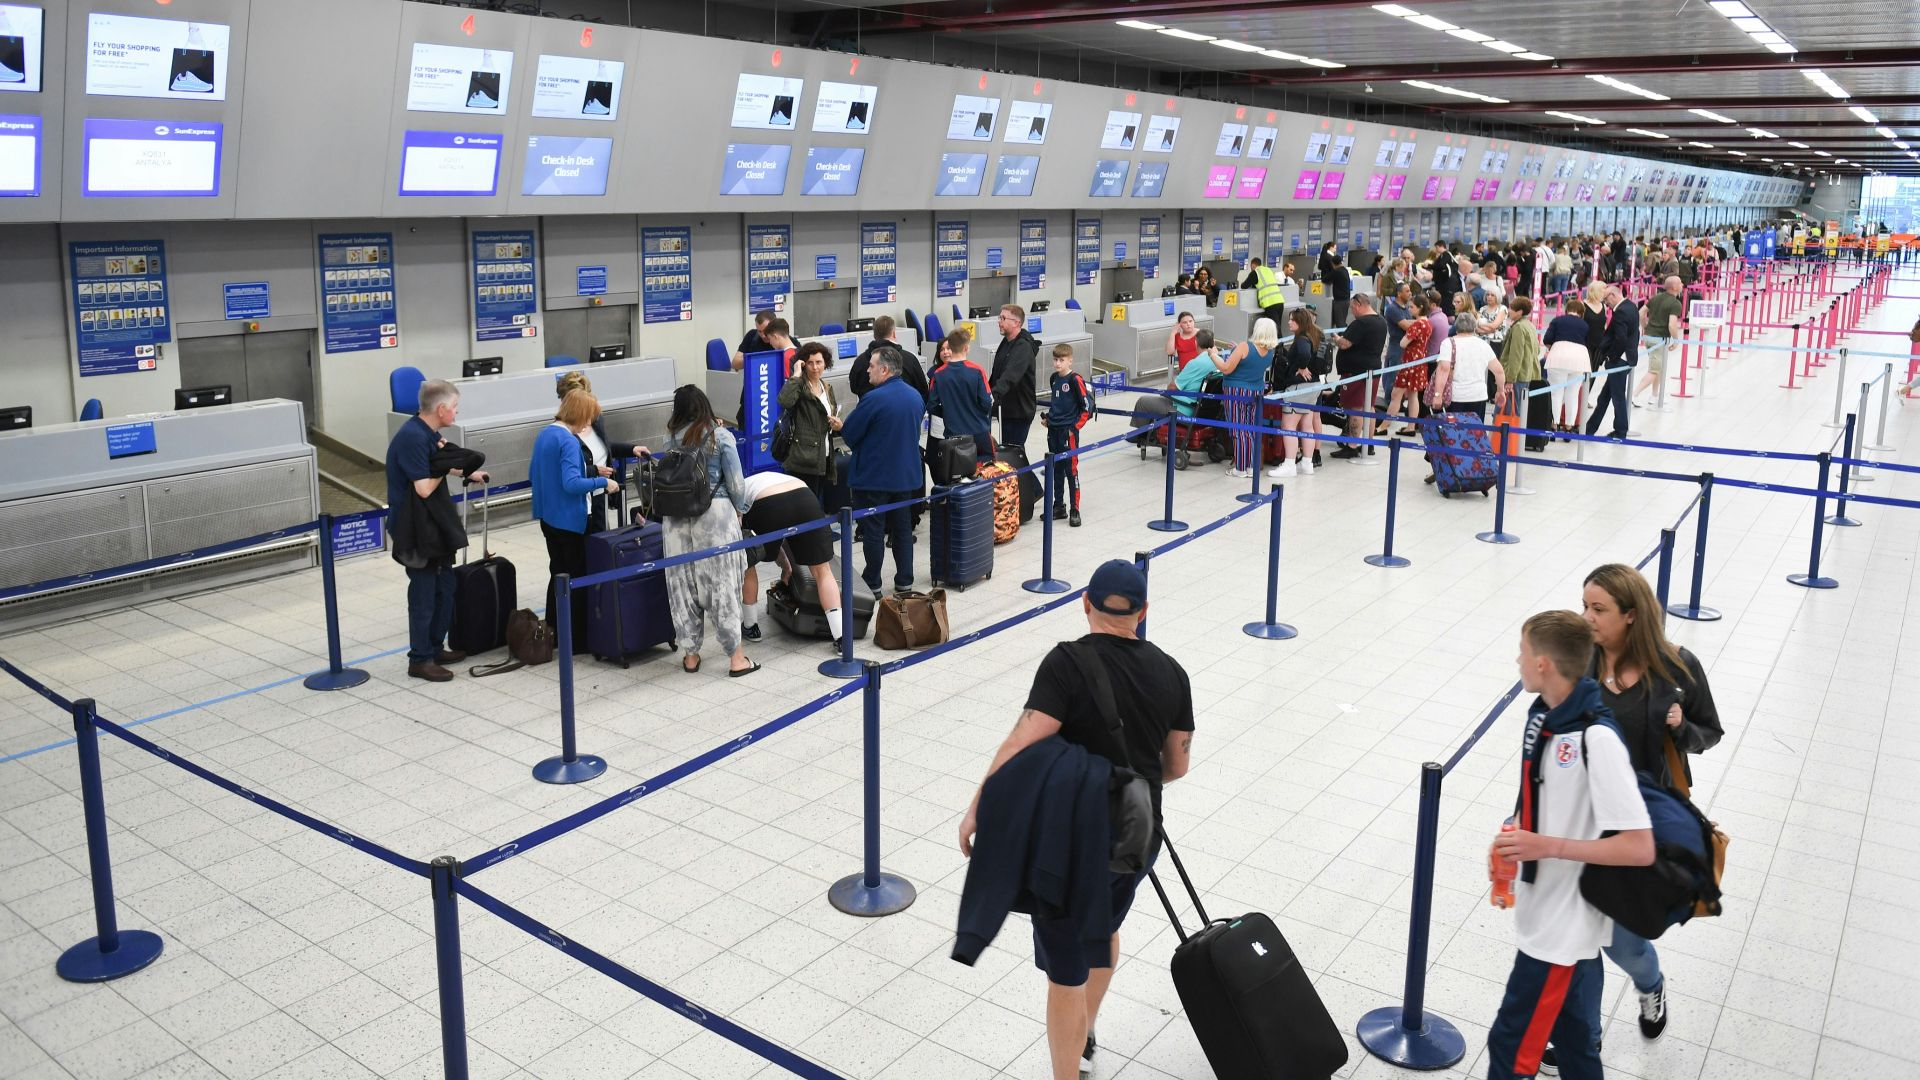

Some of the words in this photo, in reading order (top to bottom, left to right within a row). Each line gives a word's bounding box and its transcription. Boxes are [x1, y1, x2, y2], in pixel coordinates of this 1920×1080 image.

[460, 14, 476, 37] 4
[580, 27, 594, 48] 5
[107, 42, 126, 50] YOUR
[127, 43, 161, 52] SHOPPING
[771, 49, 782, 68] 6
[425, 66, 438, 74] YOUR
[438, 67, 463, 75] SHOPPING
[849, 58, 860, 76] 7
[174, 127, 216, 136] SunExpress
[135, 159, 172, 167] ANTALYA
[542, 155, 575, 166] Check-in
[576, 156, 595, 166] Desk
[736, 160, 763, 169] Check-in
[763, 160, 776, 169] Desk
[816, 162, 838, 171] Check-in
[838, 163, 851, 171] Desk
[554, 167, 579, 177] Closed
[745, 170, 765, 179] Closed
[823, 172, 840, 181] Closed
[75, 245, 113, 254] Important
[115, 245, 158, 253] Information
[760, 363, 769, 438] RYANAIR
[341, 520, 367, 530] NOTICE
[334, 535, 355, 543] baggage
[354, 538, 372, 546] placing
[1524, 712, 1546, 755] JOM
[486, 854, 501, 865] LONDON
[502, 850, 514, 859] LUTON
